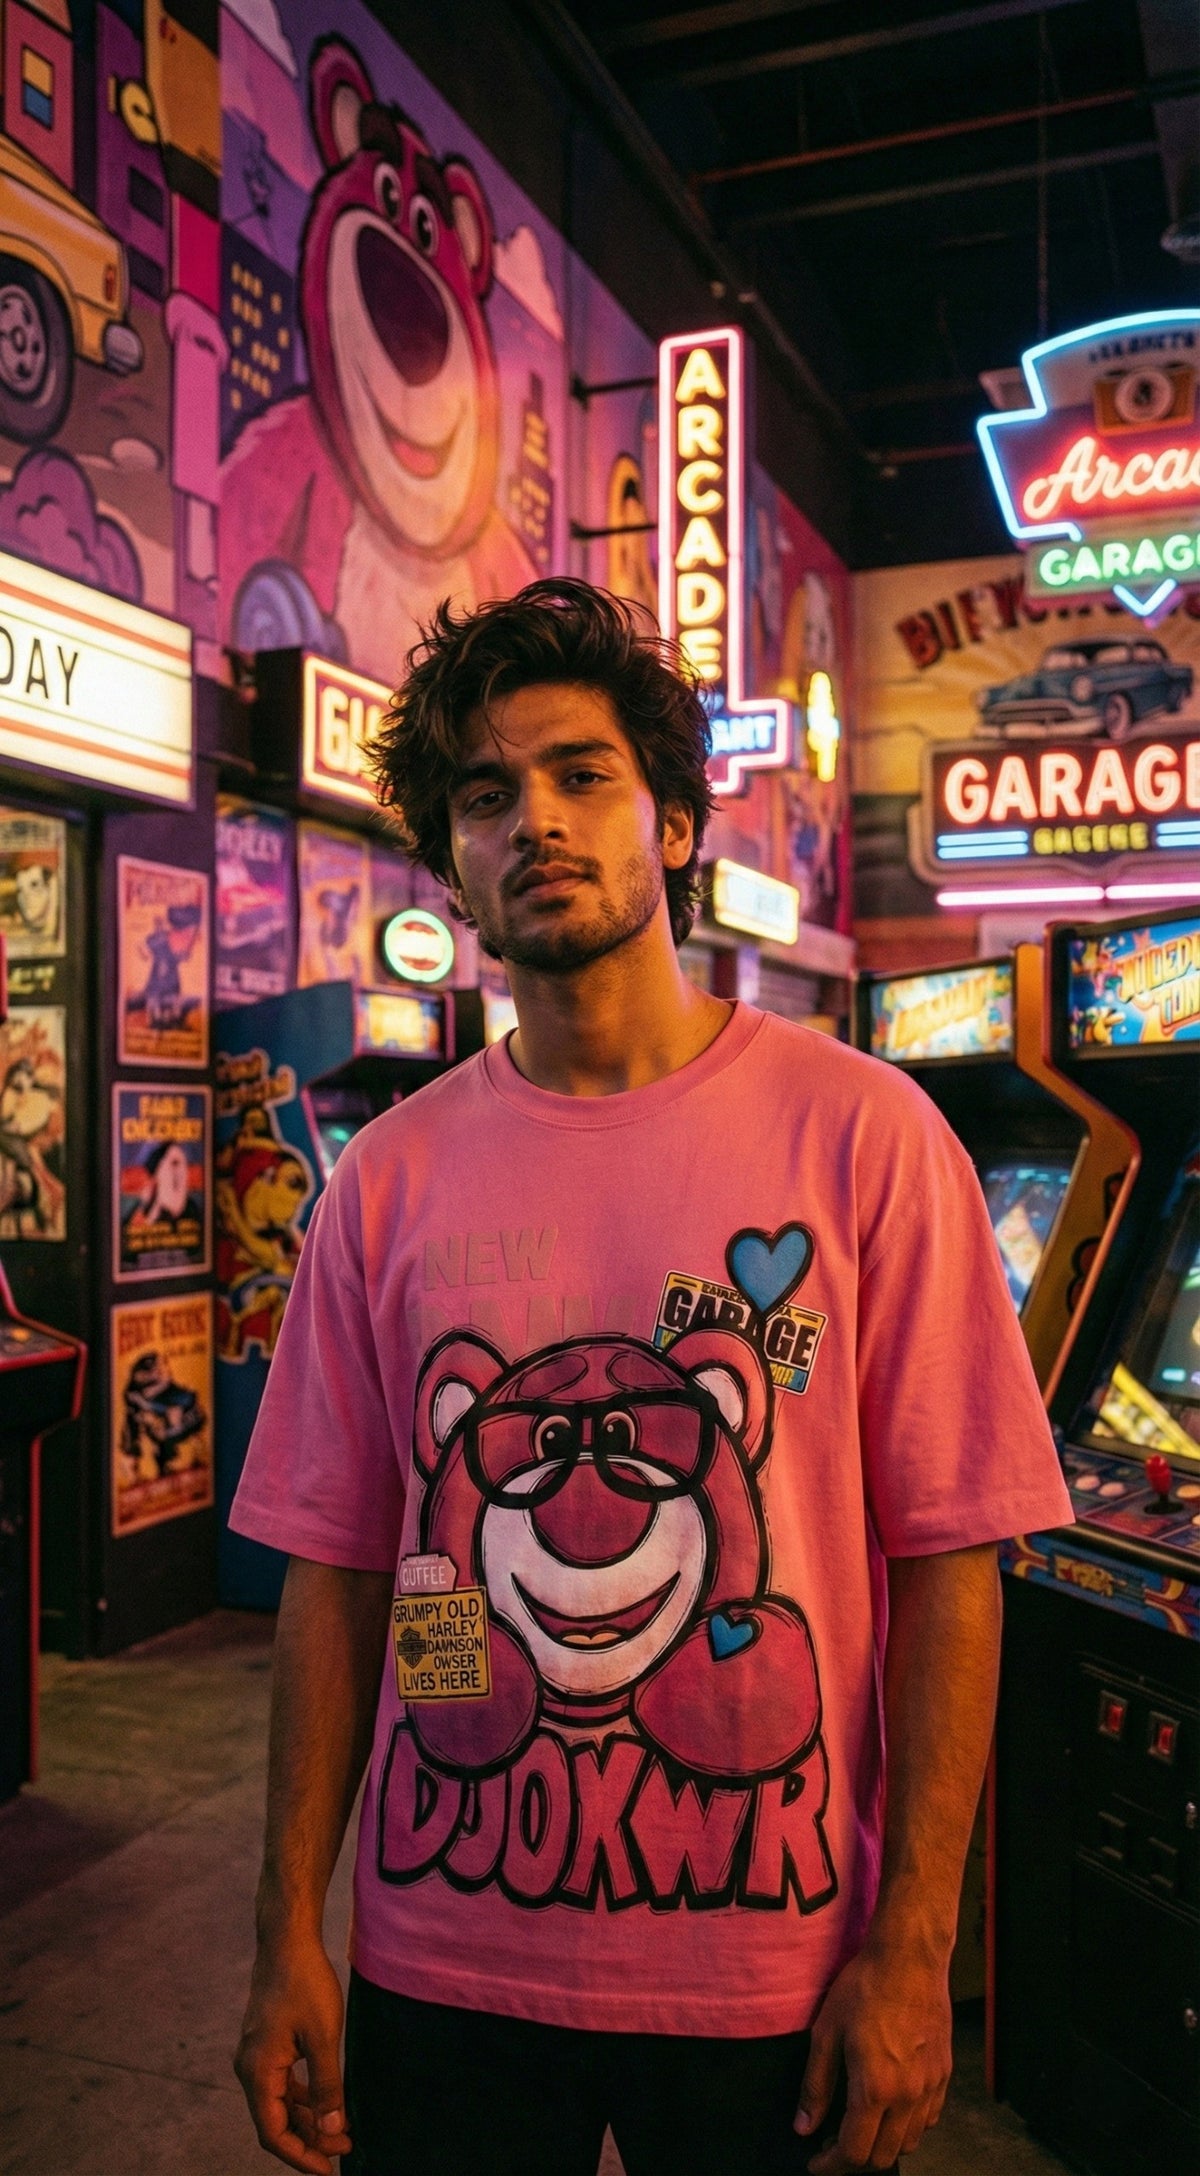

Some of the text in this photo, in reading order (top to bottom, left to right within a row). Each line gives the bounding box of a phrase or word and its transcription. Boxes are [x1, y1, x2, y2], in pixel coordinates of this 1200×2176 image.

[674, 348, 727, 682] ARCADE
[1039, 533, 1200, 586] GARAG
[423, 1225, 558, 1292] NEW
[393, 1598, 480, 1623] GRUMPY OLD
[427, 1619, 477, 1638] HARLEY
[434, 1654, 476, 1670] OWSER
[403, 1670, 481, 1692] LIVES HERE
